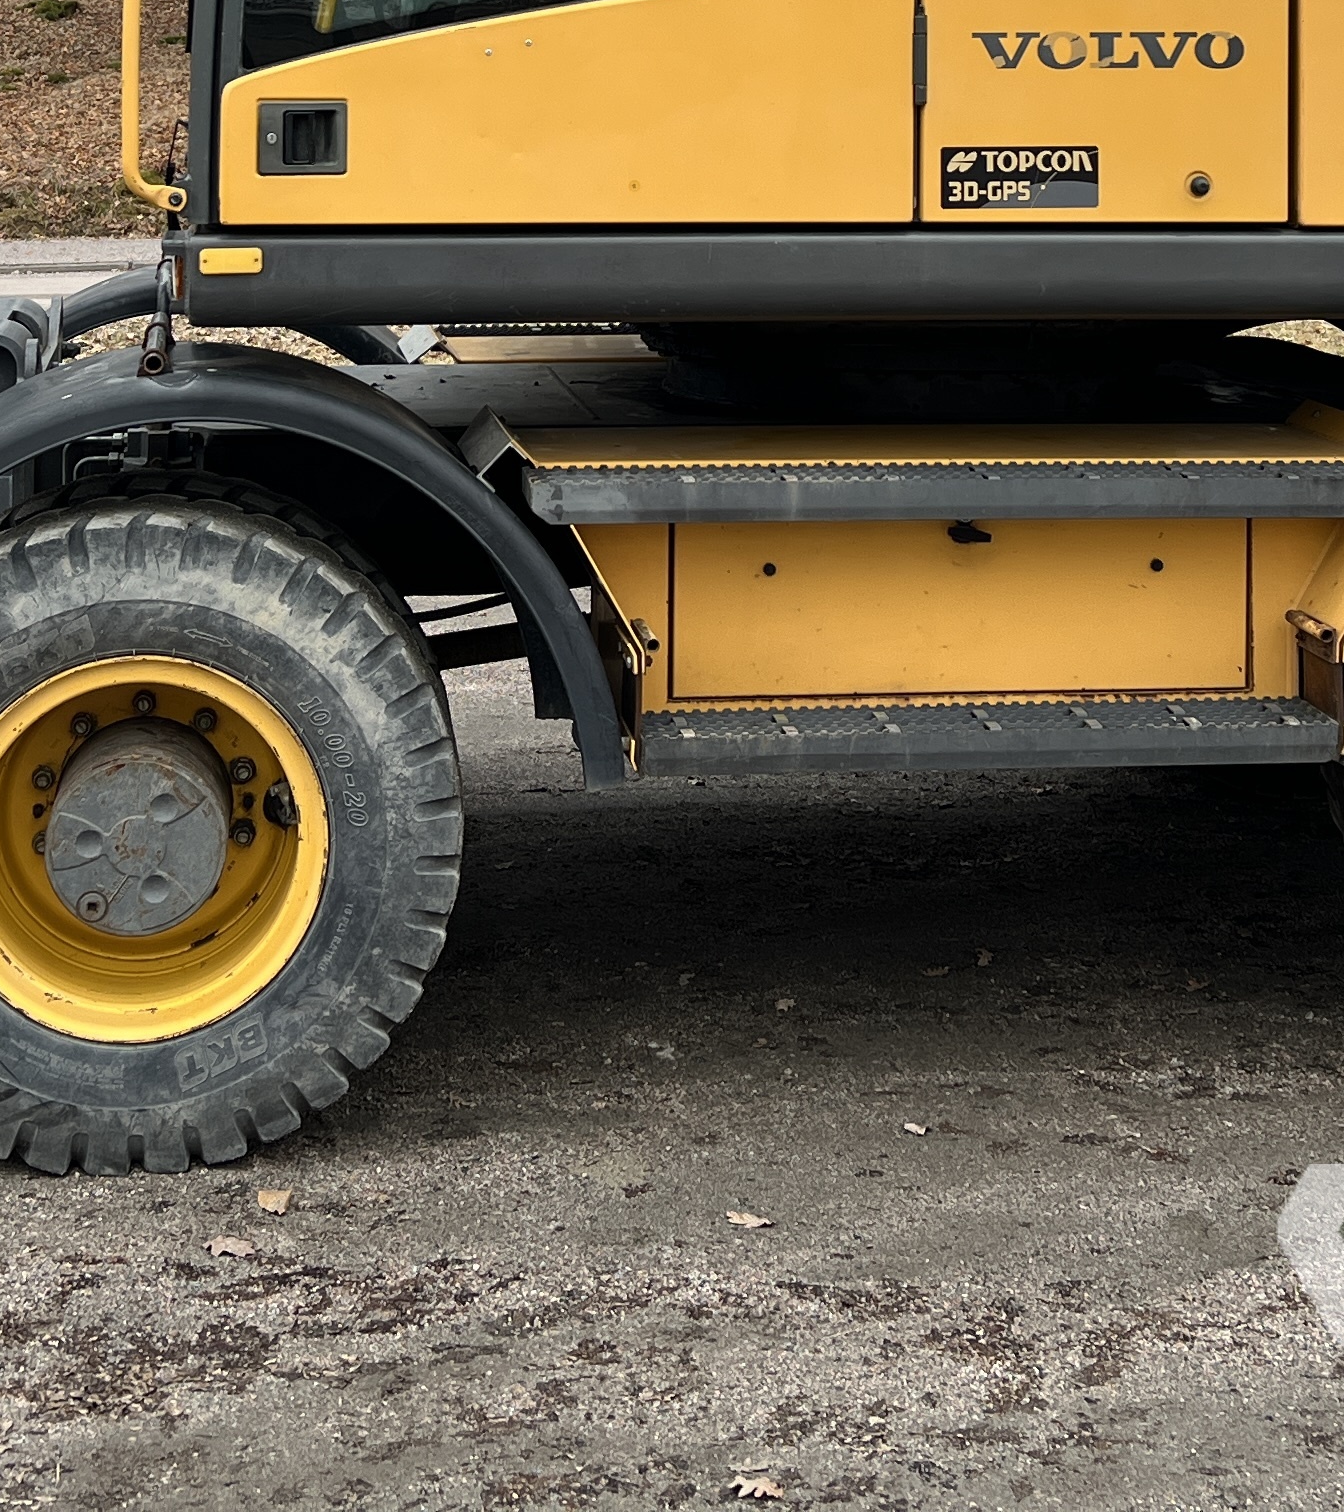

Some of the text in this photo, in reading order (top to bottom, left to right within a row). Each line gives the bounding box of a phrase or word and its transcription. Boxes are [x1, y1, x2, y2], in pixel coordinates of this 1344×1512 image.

[971, 31, 1245, 70] VOLVO
[980, 149, 1094, 173] TOPCON
[947, 180, 1032, 202] 3D-GPS
[297, 695, 369, 827] 10.00-20
[175, 1013, 268, 1091] BKT
